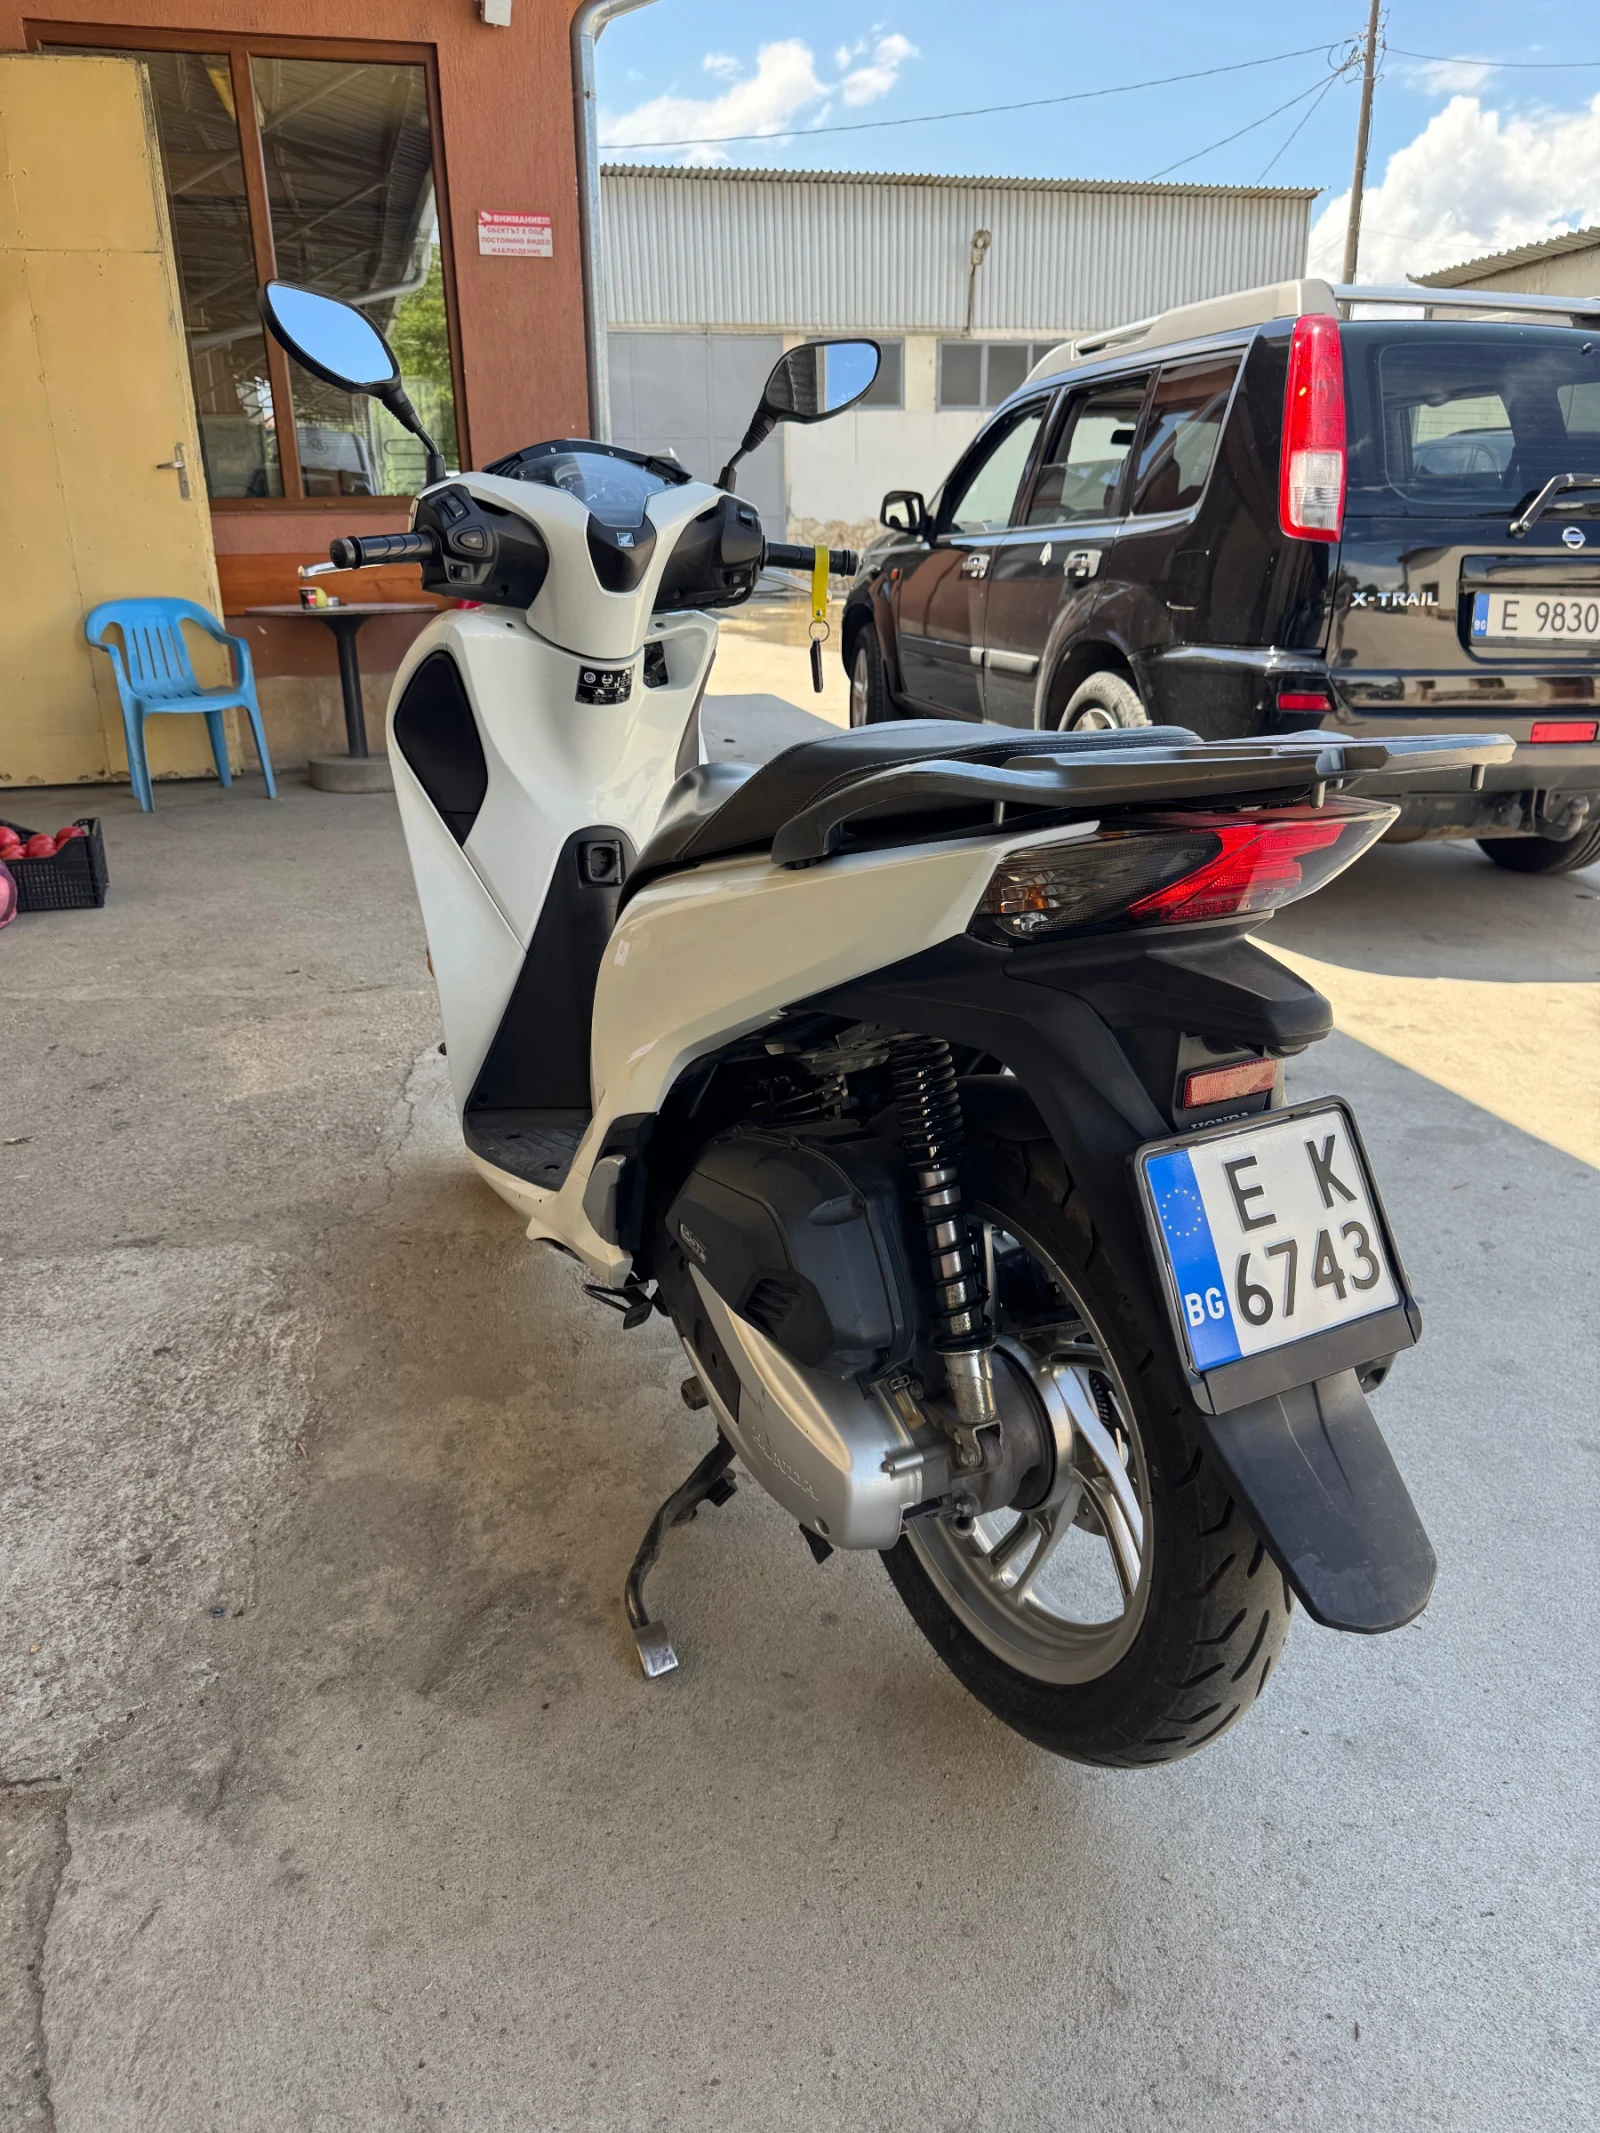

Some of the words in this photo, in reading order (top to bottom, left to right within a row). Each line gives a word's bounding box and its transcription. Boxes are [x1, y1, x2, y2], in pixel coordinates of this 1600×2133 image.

[493, 214, 551, 225] ВНИМАНИЕ!!!
[487, 227, 520, 235] ОБЕКТЪТ
[481, 236, 525, 245] ПОСТОЯННО
[526, 238, 551, 246] ВИДЕО
[491, 247, 541, 255] НАБЛЮДЕНИЕ
[1350, 591, 1440, 608] X-TRAIL
[1501, 600, 1520, 631] E
[1535, 601, 1599, 633] 9830
[1474, 619, 1487, 632] BG
[1223, 1155, 1277, 1233] E
[1305, 1133, 1358, 1209] K
[1236, 1220, 1380, 1327] 6743
[1184, 1287, 1225, 1327] BG
